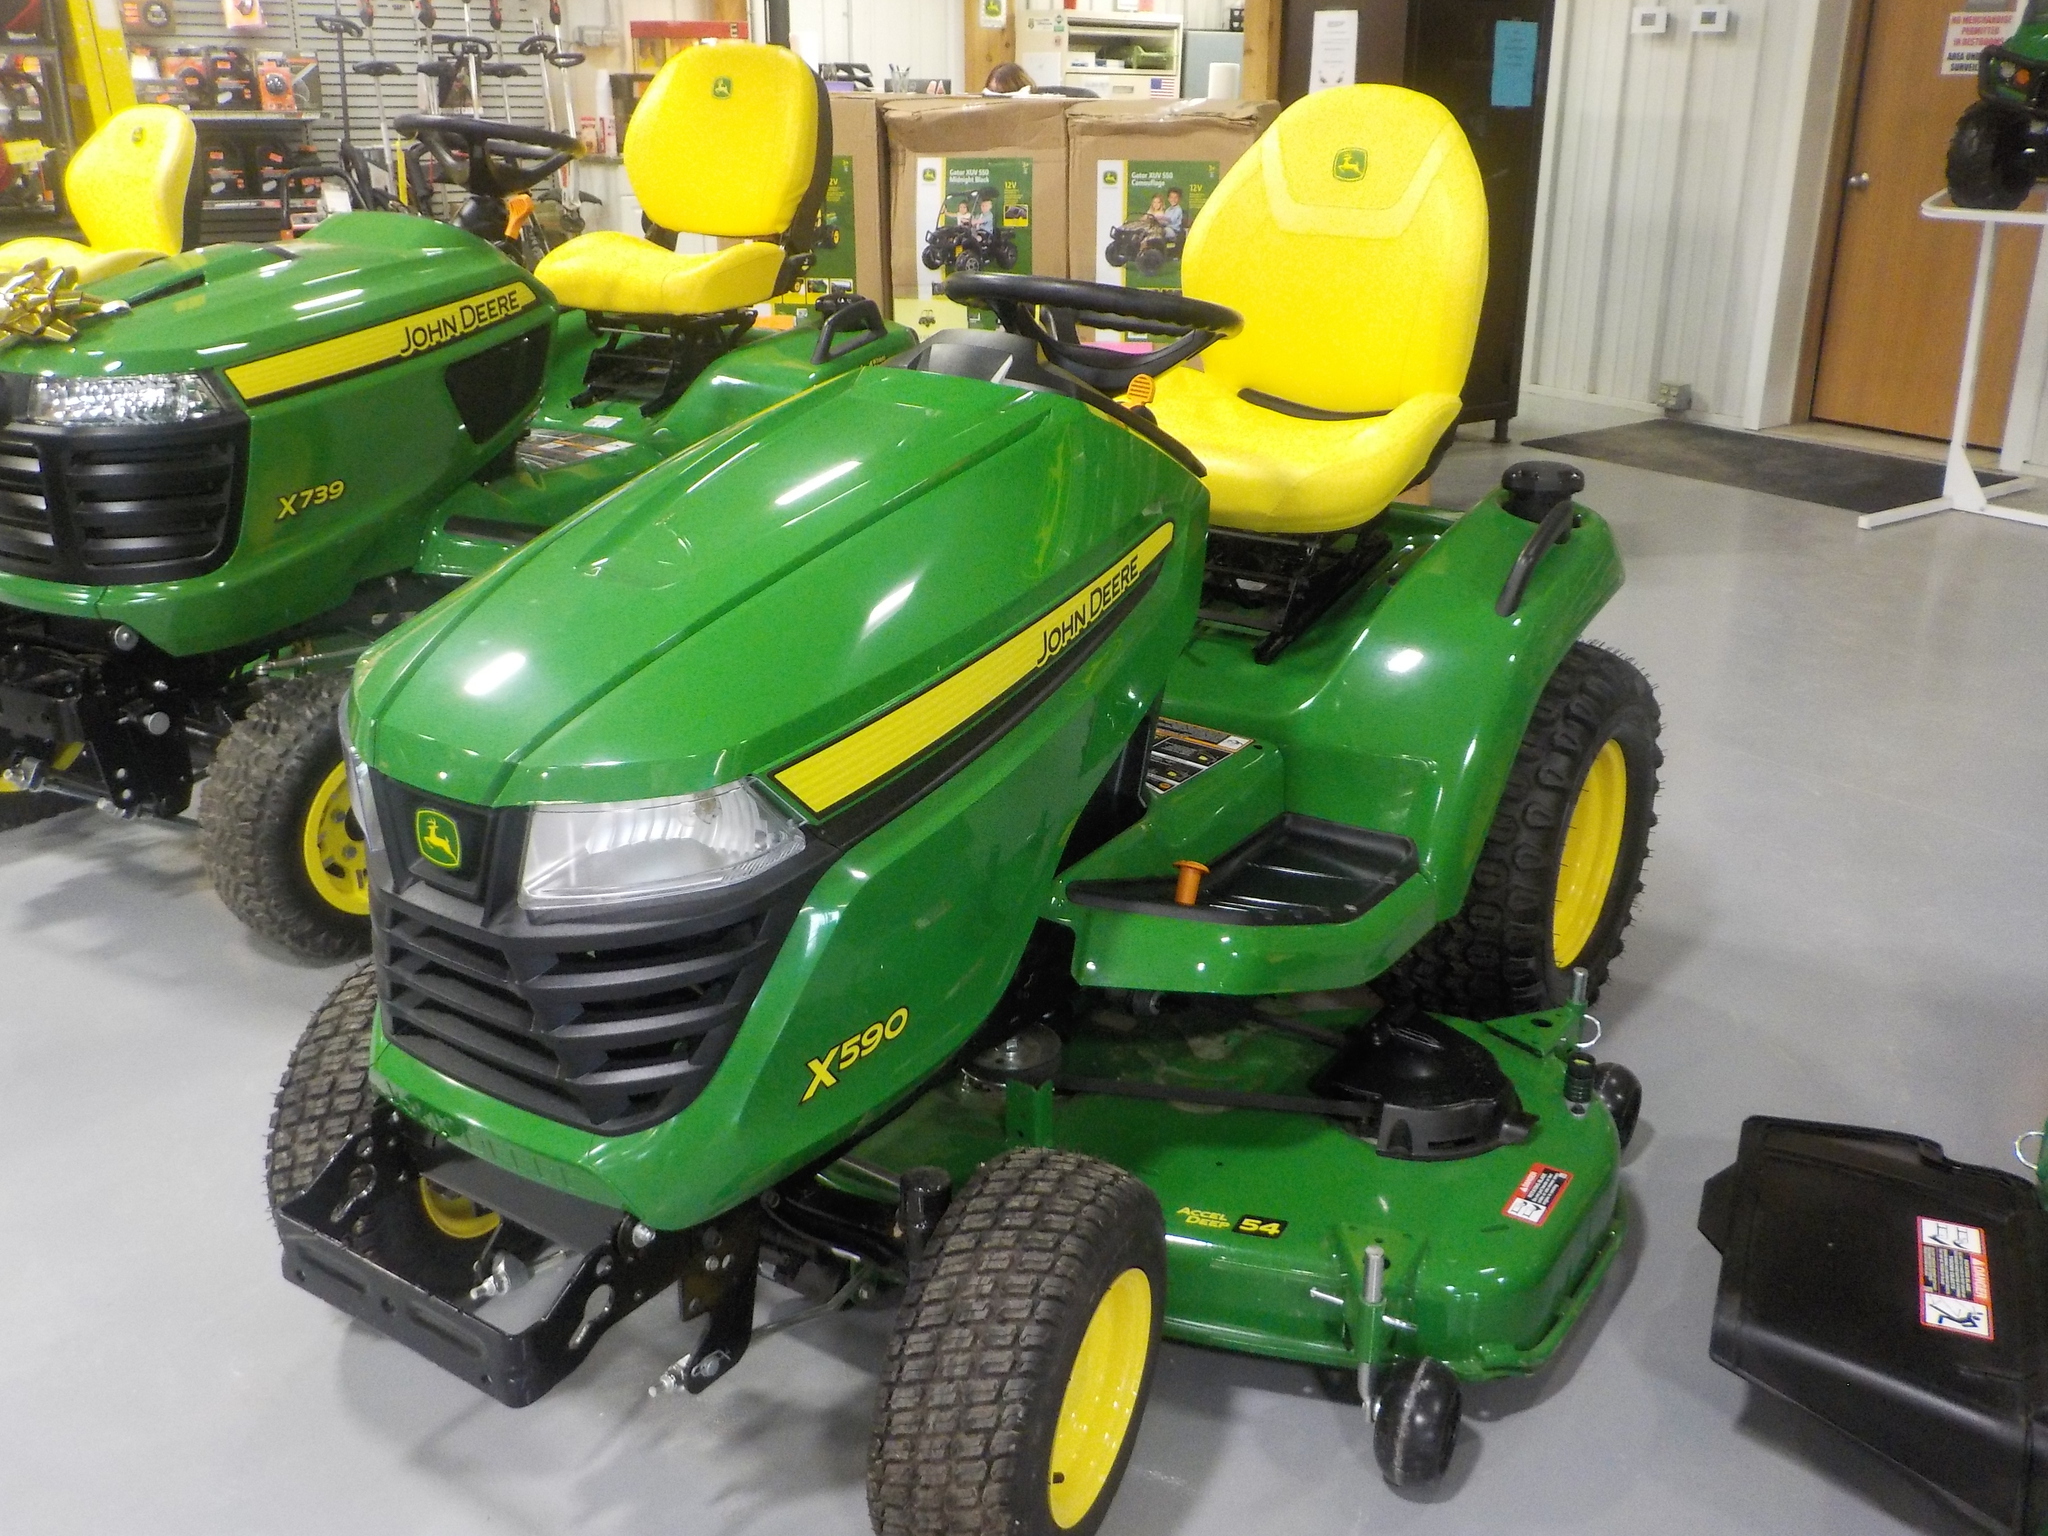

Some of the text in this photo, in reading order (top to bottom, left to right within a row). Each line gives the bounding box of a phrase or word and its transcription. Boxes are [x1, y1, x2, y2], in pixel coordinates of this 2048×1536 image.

[1004, 181, 1017, 189] 12V
[1189, 184, 1203, 192] 12V
[400, 290, 520, 353] JOHN DEERE
[276, 479, 345, 520] X739
[1036, 554, 1139, 666] JOHN DEERE
[800, 1005, 909, 1104] X590
[1176, 1206, 1228, 1221] ACCEL
[1185, 1215, 1281, 1236] DEEP 54
